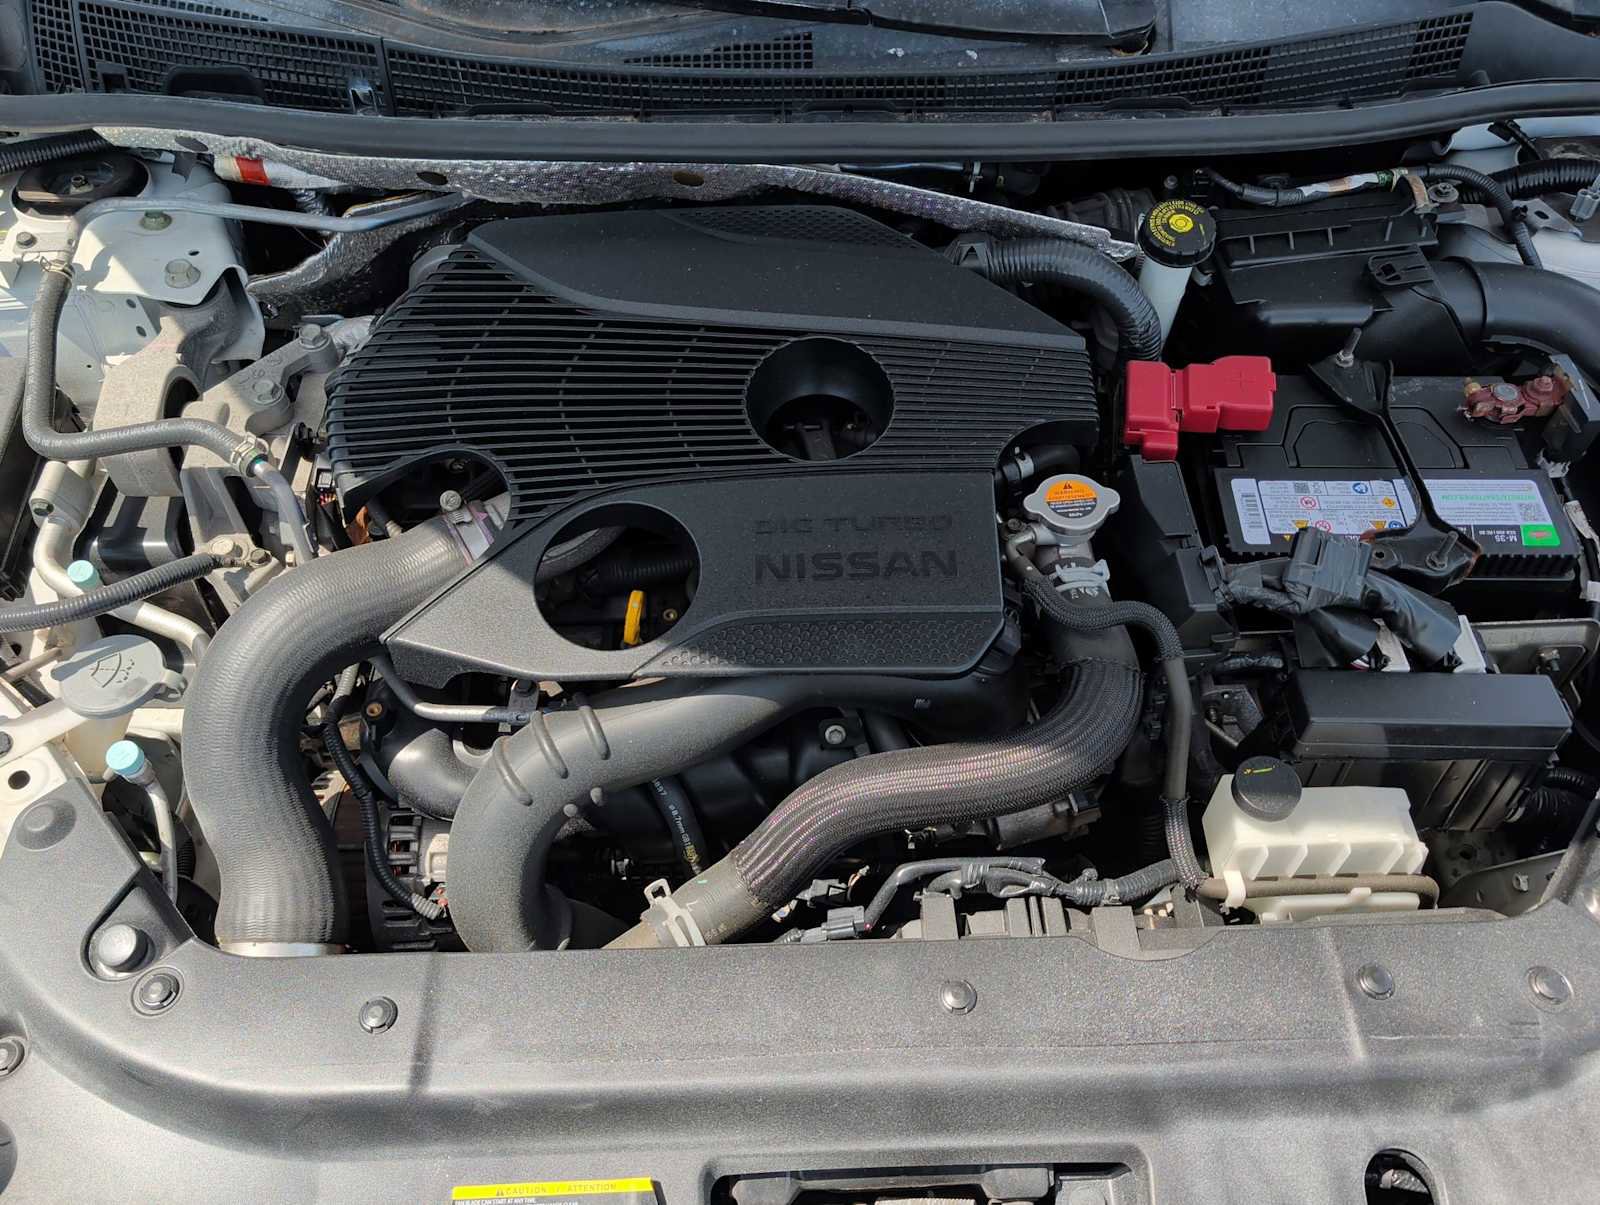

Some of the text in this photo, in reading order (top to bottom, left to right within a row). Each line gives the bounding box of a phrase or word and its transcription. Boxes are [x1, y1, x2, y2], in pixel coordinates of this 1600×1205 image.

[822, 514, 952, 533] TURBO
[754, 550, 958, 582] NISSAN
[505, 1186, 547, 1196] CAUTION
[567, 1183, 617, 1192] ATTENTION
